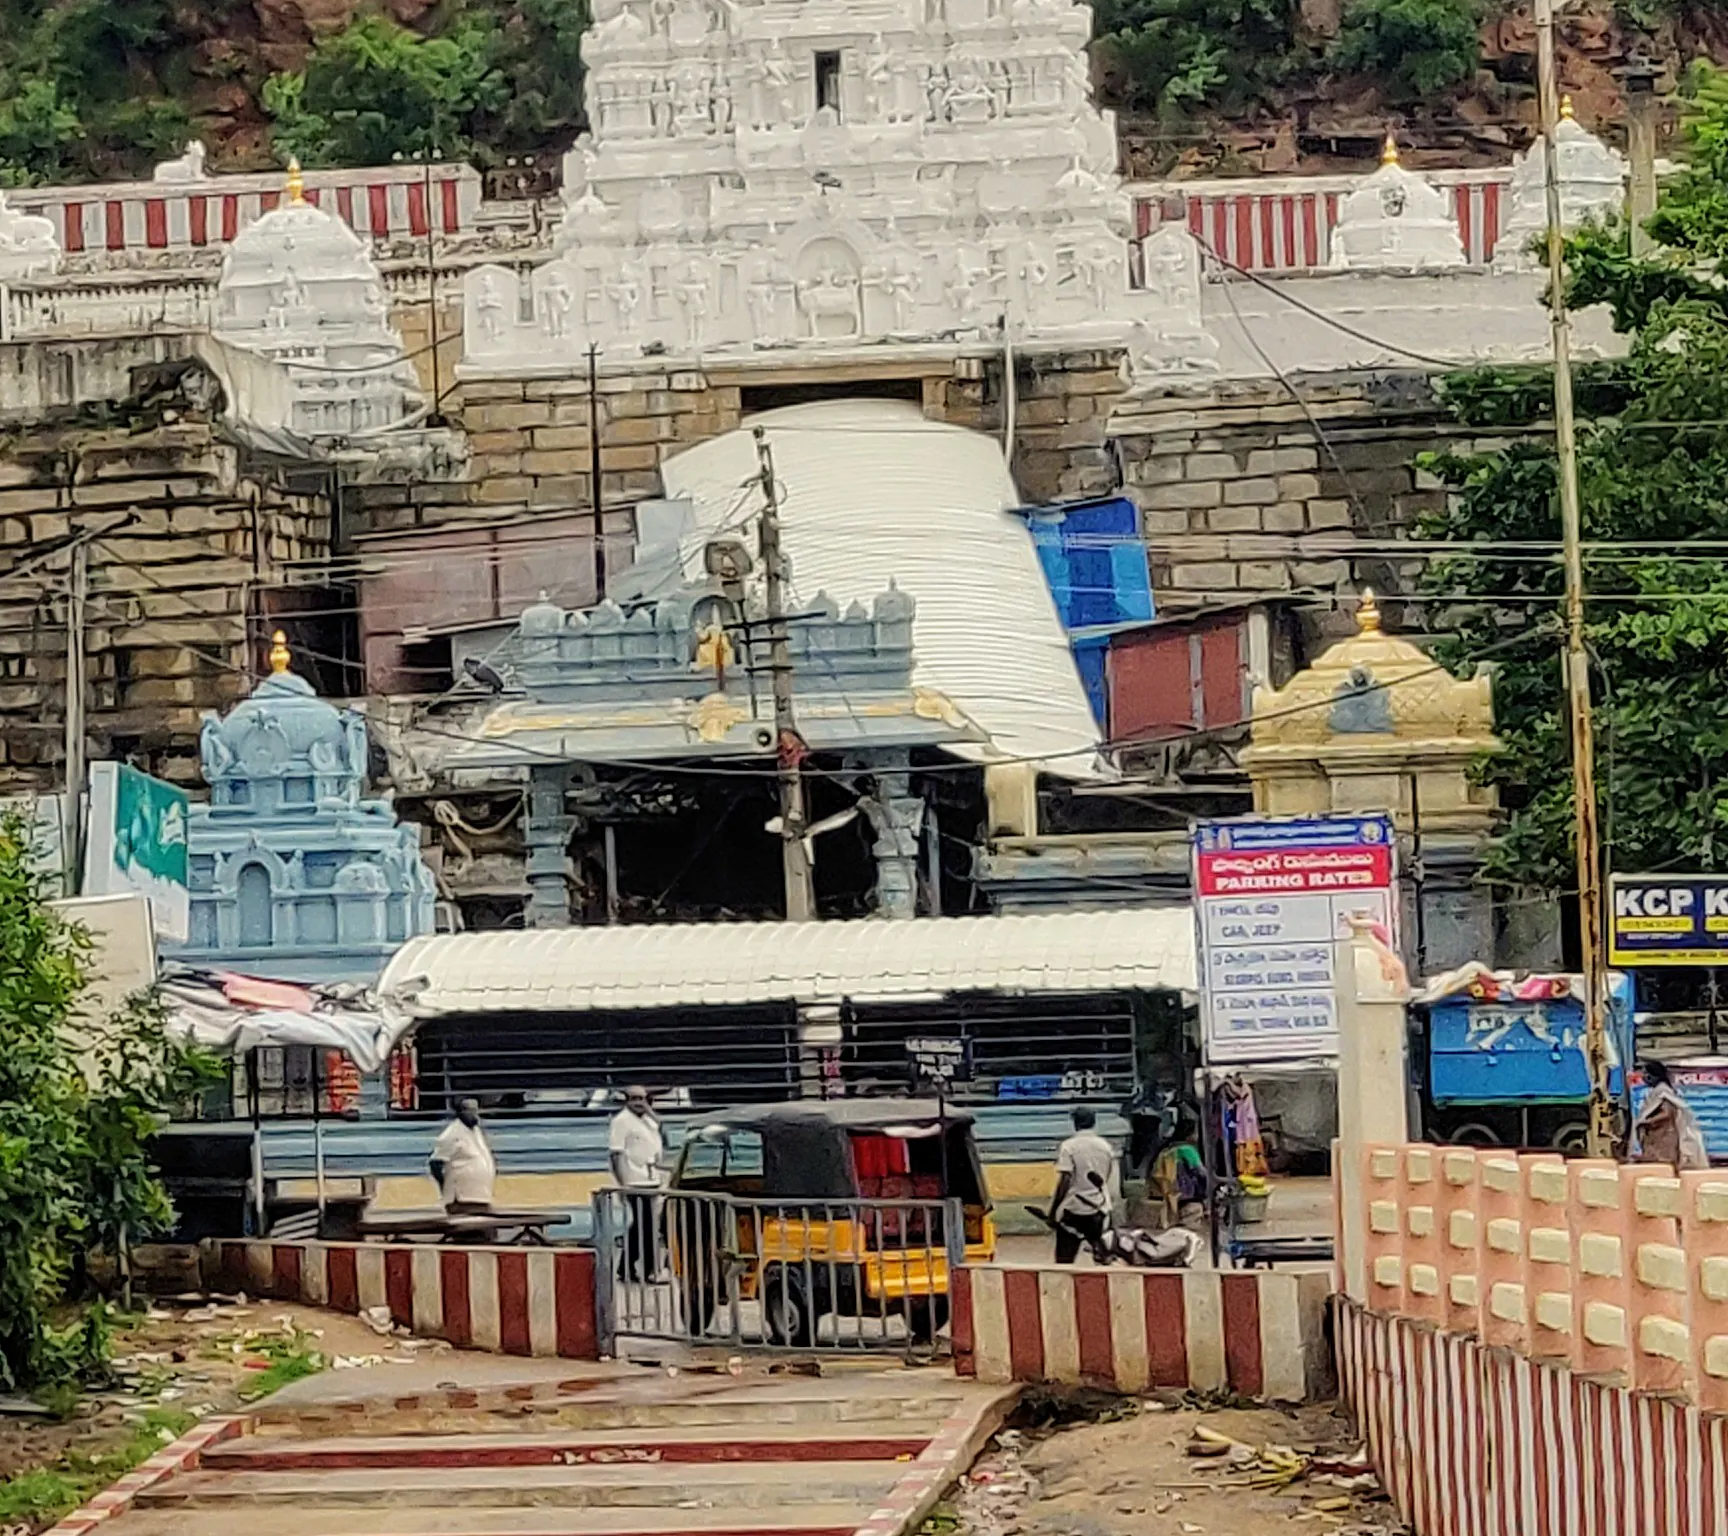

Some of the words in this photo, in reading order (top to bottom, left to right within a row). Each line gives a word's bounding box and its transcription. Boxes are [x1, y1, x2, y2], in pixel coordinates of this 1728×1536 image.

[1216, 873, 1304, 891] PARKING
[1308, 870, 1374, 887] RATES
[1616, 889, 1694, 916] KCP
